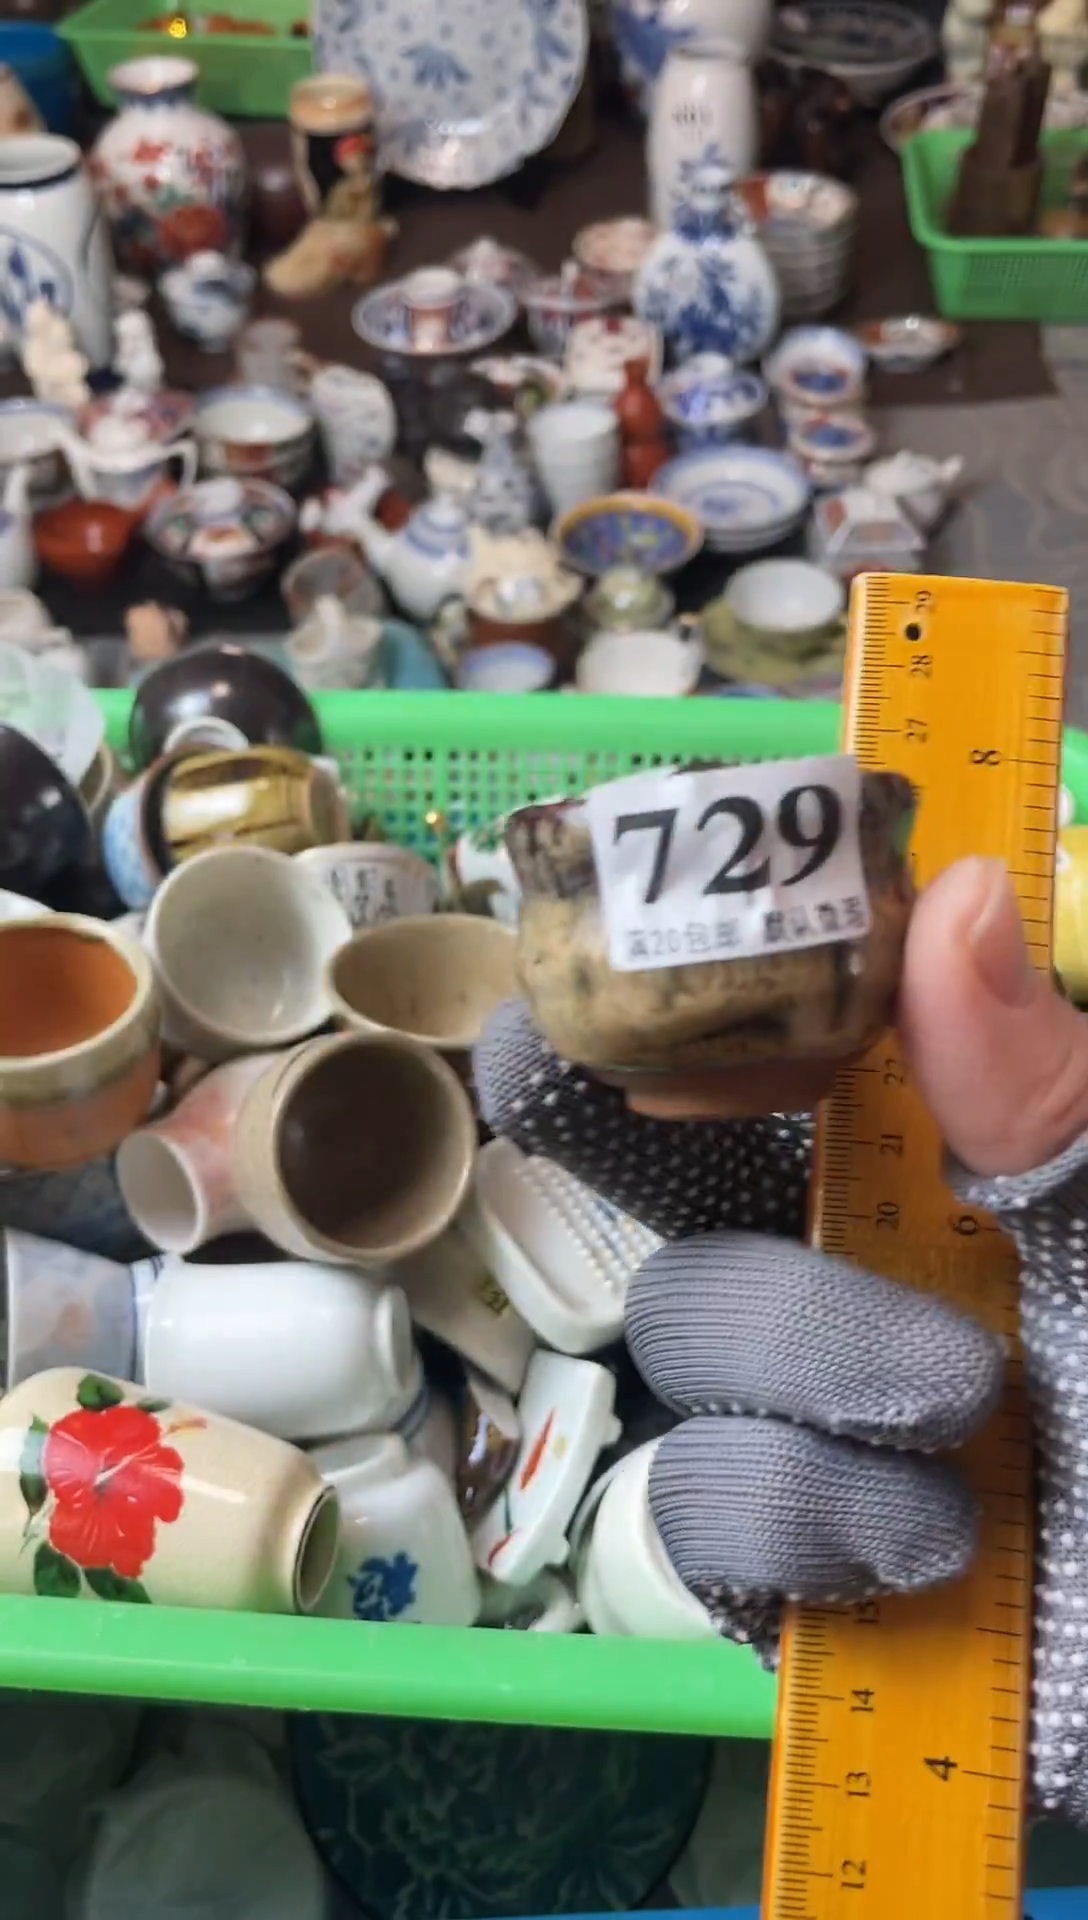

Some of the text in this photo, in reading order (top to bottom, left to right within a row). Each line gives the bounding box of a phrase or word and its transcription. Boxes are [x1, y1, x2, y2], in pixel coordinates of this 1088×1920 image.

[914, 589, 936, 612] 29
[910, 653, 933, 678] 28
[905, 718, 928, 742] 27
[969, 749, 1002, 767] 8
[613, 783, 842, 904] 729
[879, 1133, 904, 1158] 21
[876, 1201, 900, 1231] 20
[952, 1214, 980, 1236] 6
[850, 1687, 875, 1714] 14
[923, 1755, 958, 1781] 4
[845, 1771, 871, 1799] 13
[841, 1859, 867, 1891] 12
